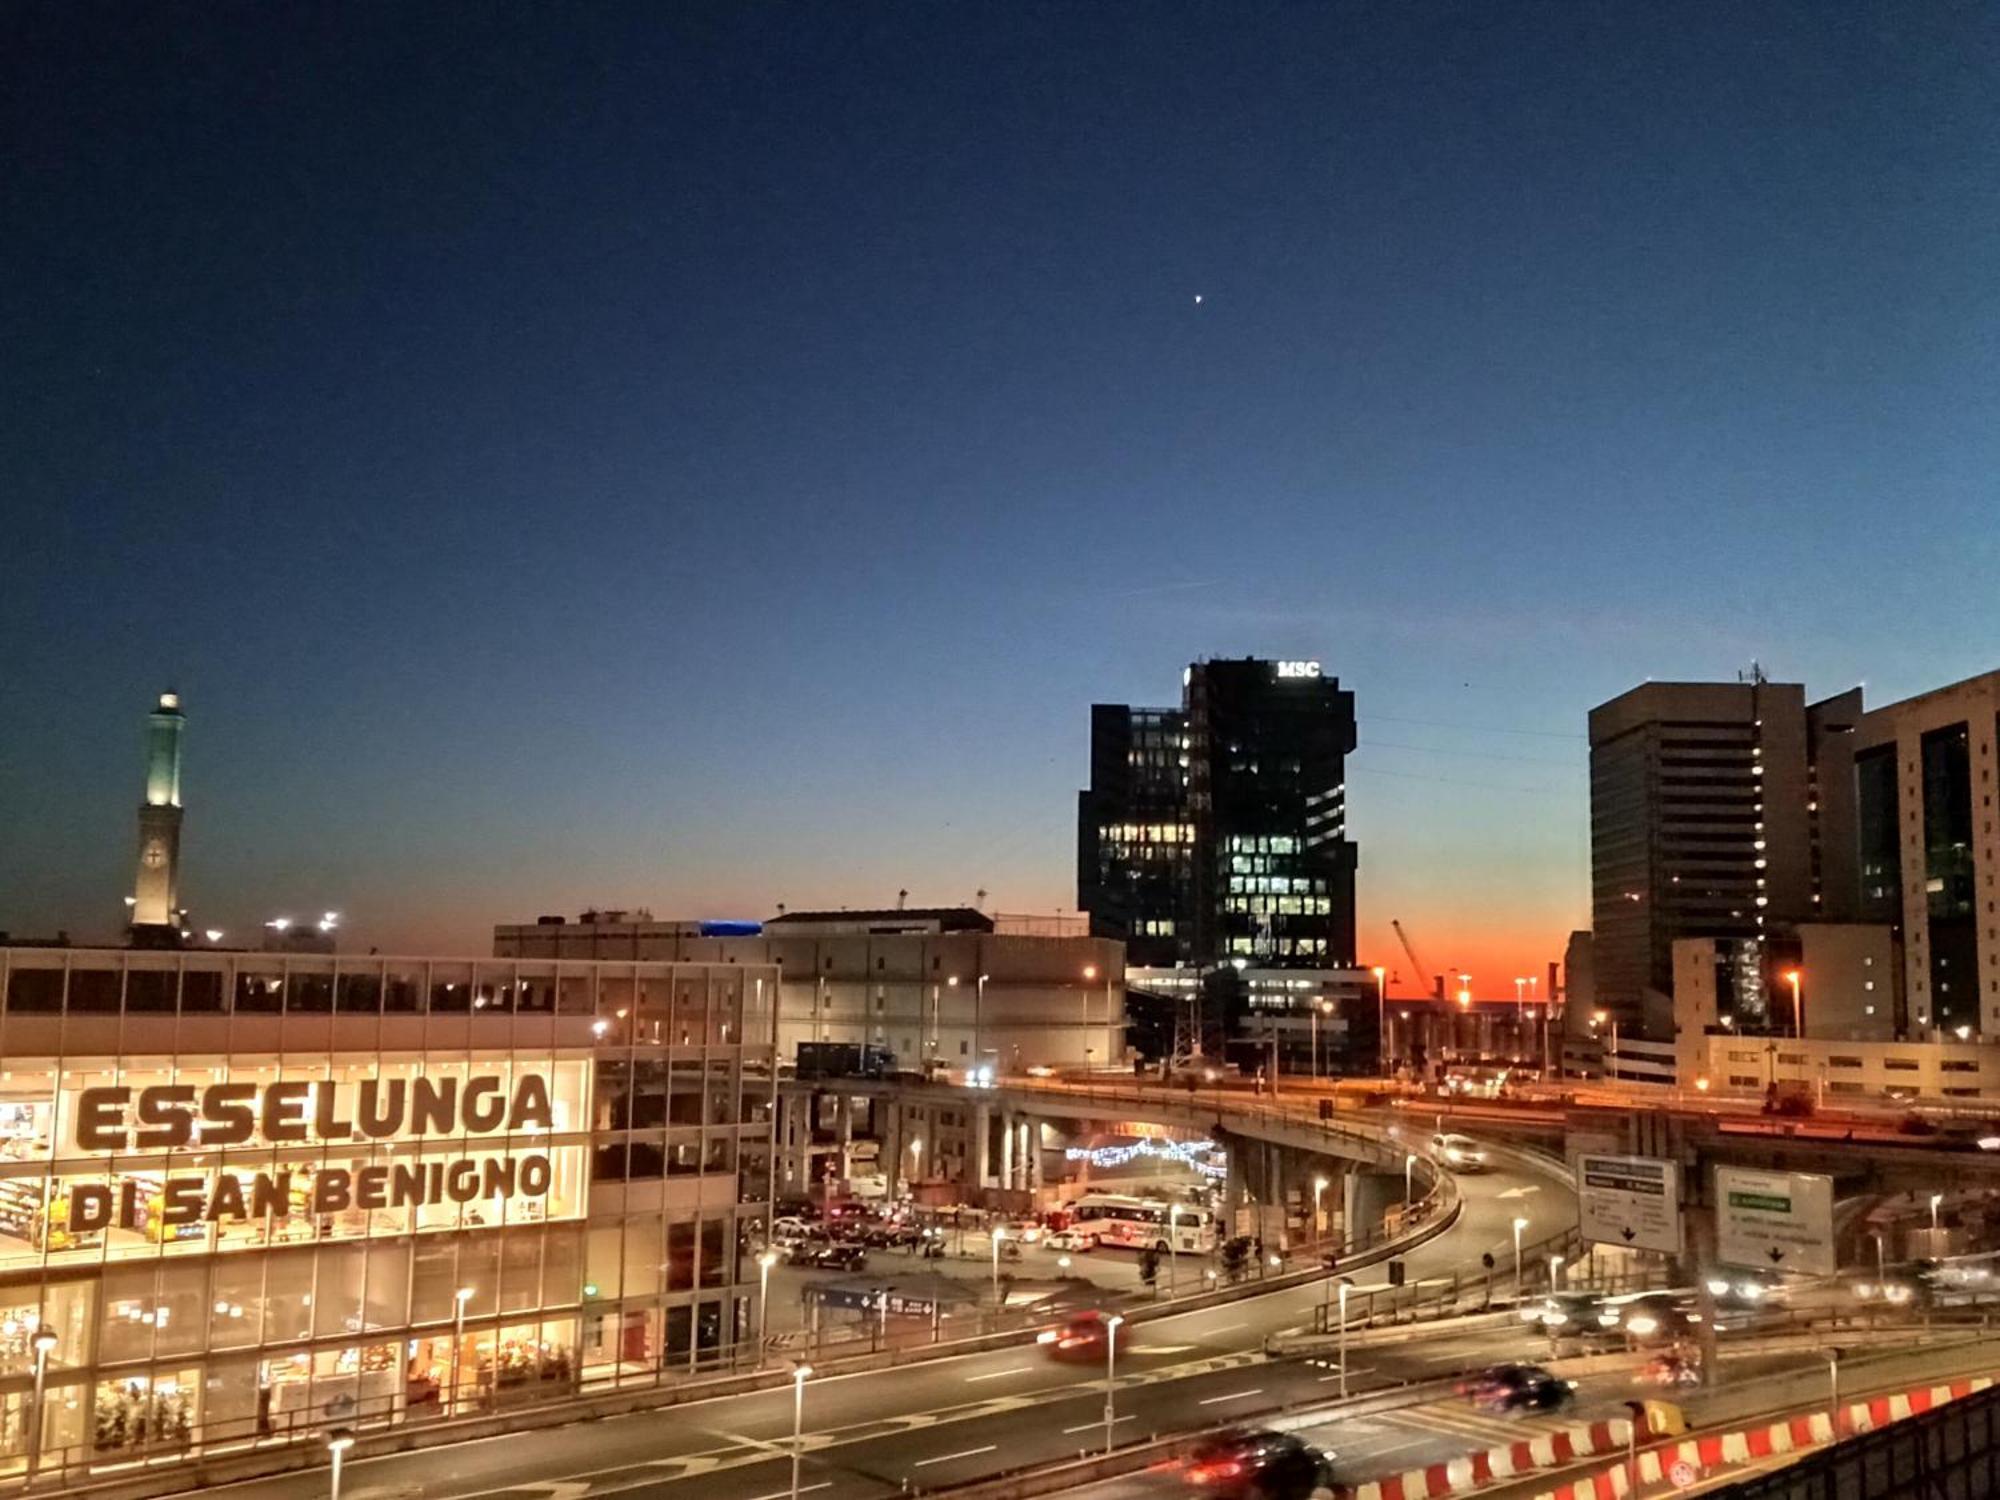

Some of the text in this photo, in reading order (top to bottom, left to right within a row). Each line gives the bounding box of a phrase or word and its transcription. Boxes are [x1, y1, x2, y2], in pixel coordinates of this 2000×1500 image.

[1278, 661, 1320, 678] MSC
[76, 1074, 553, 1150] ESSELUNGA
[71, 1155, 552, 1232] DI SAN BENIGNO
